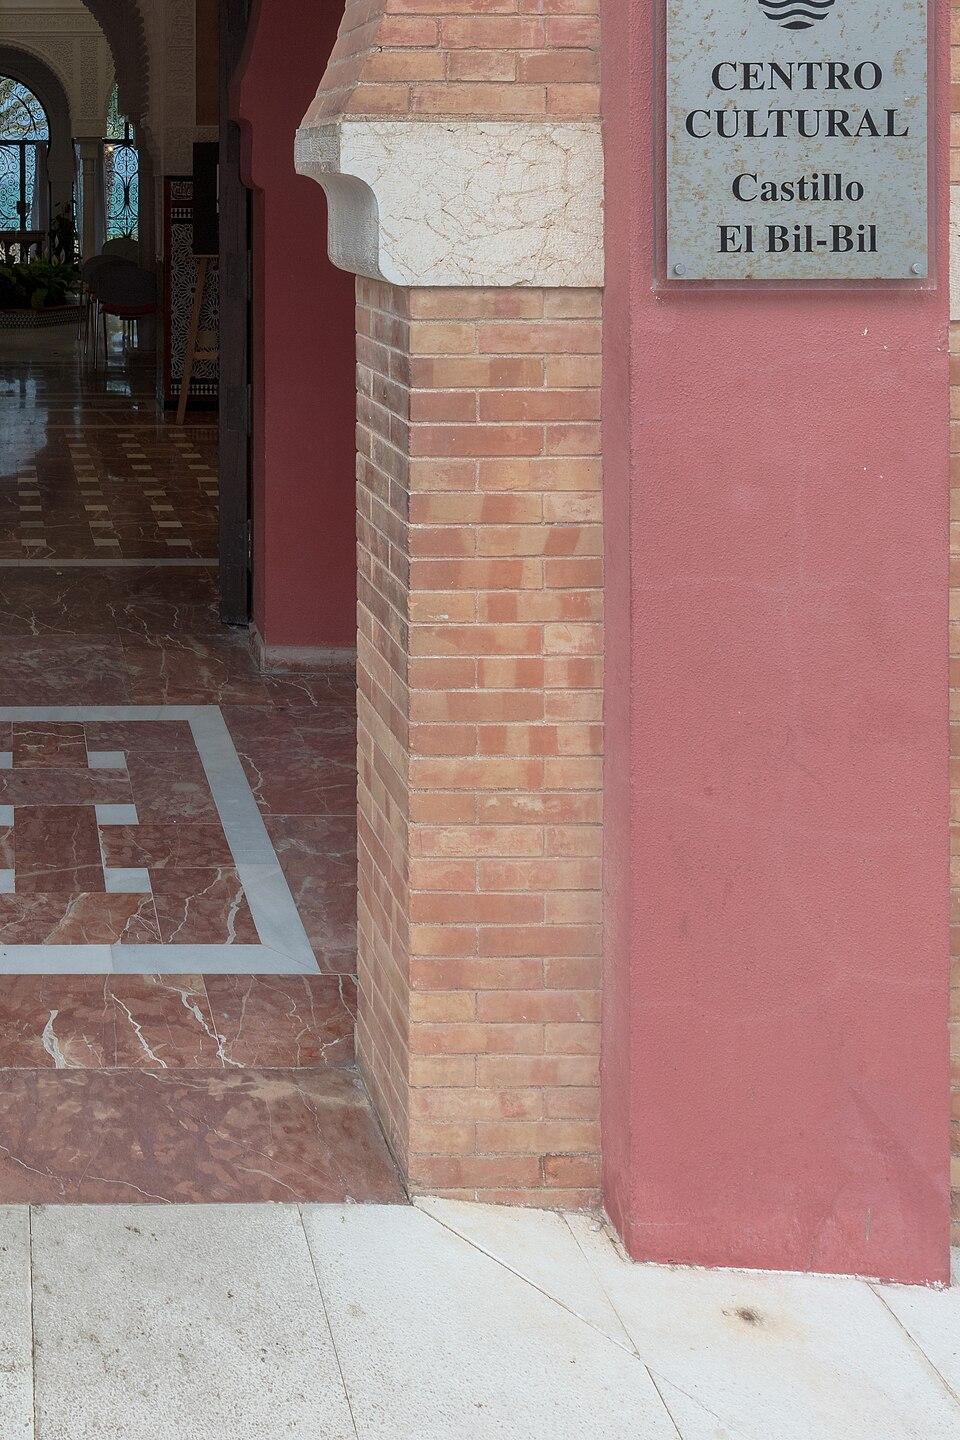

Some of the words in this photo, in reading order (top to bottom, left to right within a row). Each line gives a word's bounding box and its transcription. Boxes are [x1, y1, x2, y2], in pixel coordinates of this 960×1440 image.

[711, 61, 883, 91] CENTRO
[685, 108, 910, 139] CULTURAL
[731, 172, 865, 202] Castillo
[716, 224, 754, 254] El
[764, 223, 879, 254] Bil-Bil
